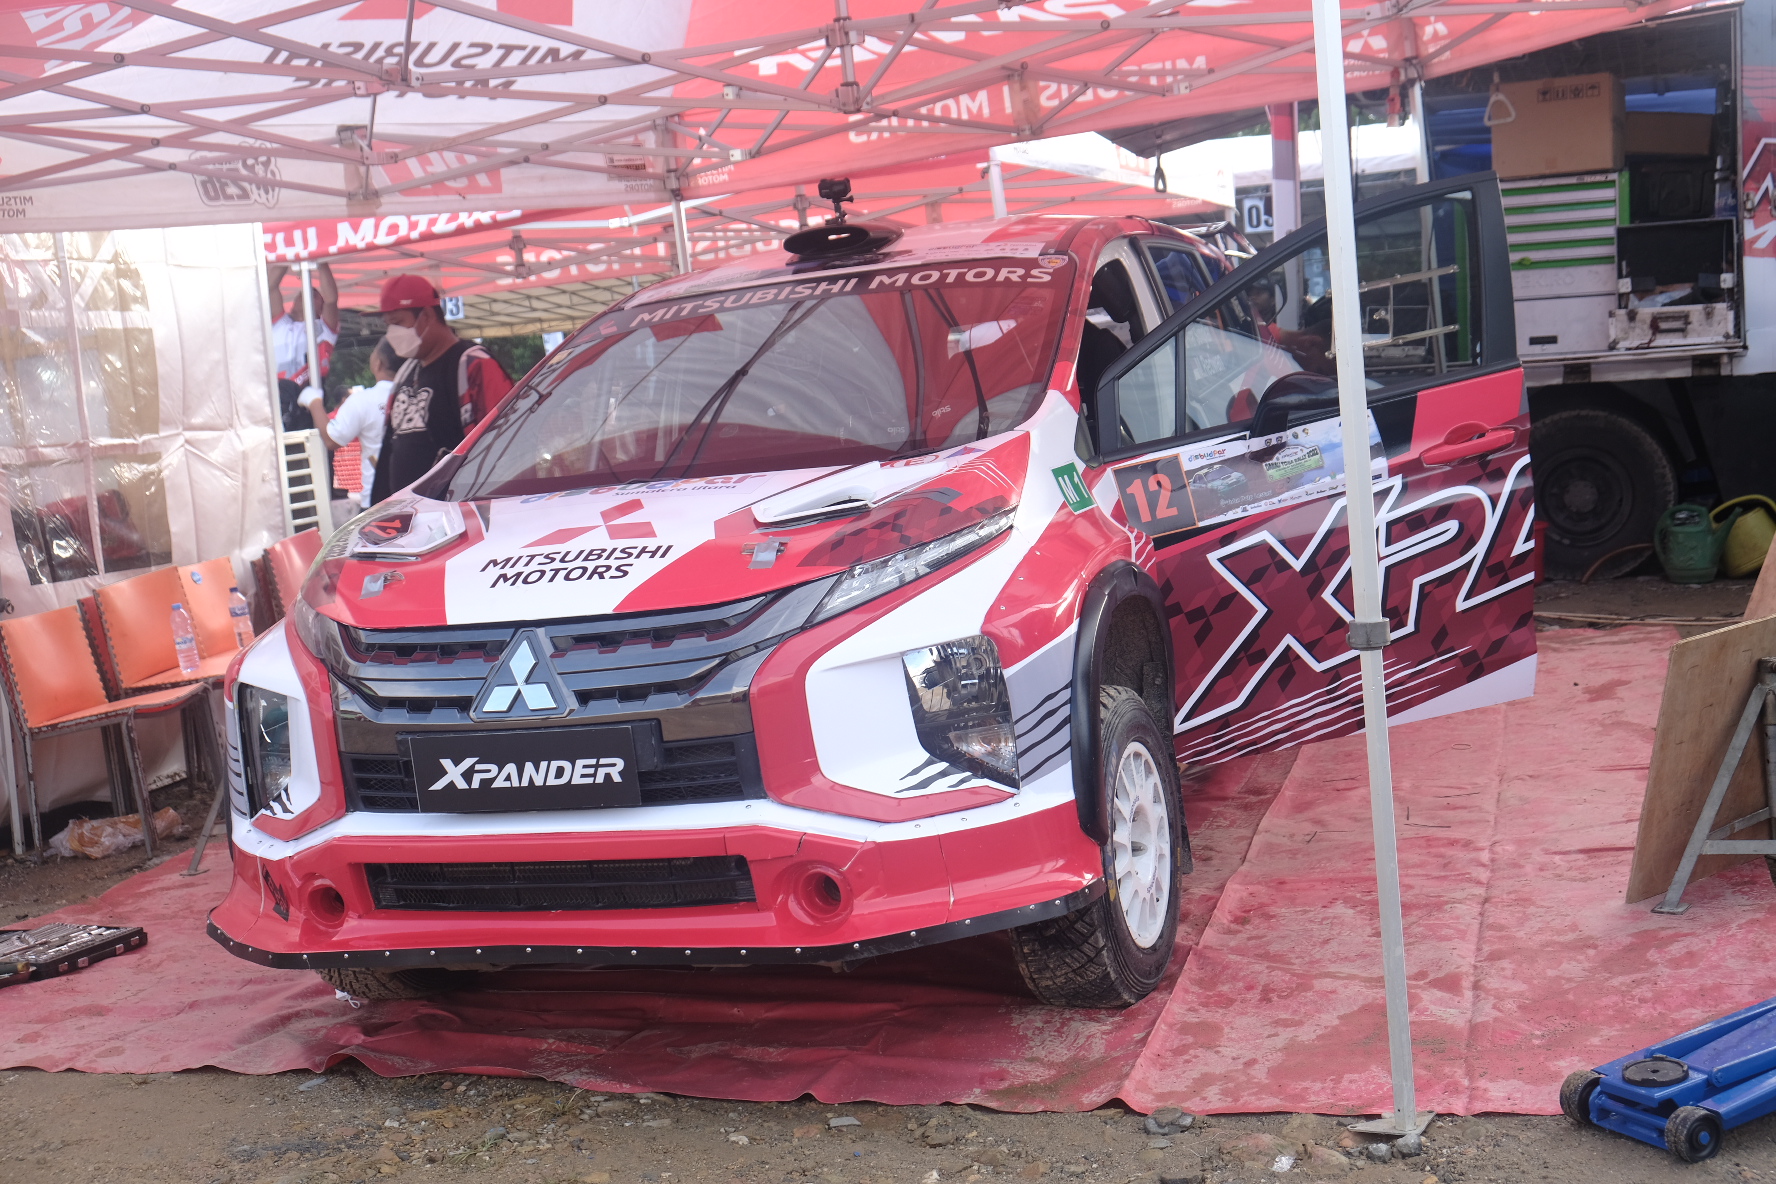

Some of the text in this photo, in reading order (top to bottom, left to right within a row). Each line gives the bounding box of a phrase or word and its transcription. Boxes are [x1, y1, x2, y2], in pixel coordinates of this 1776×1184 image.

[629, 277, 860, 328] MITSUBISHI
[867, 266, 1054, 290] MOTORS
[1058, 471, 1089, 504] M 1
[1125, 473, 1179, 523] 12
[479, 544, 674, 573] MITSUBISHI
[489, 563, 634, 589] MOTORS
[427, 756, 625, 791] XPANDER
